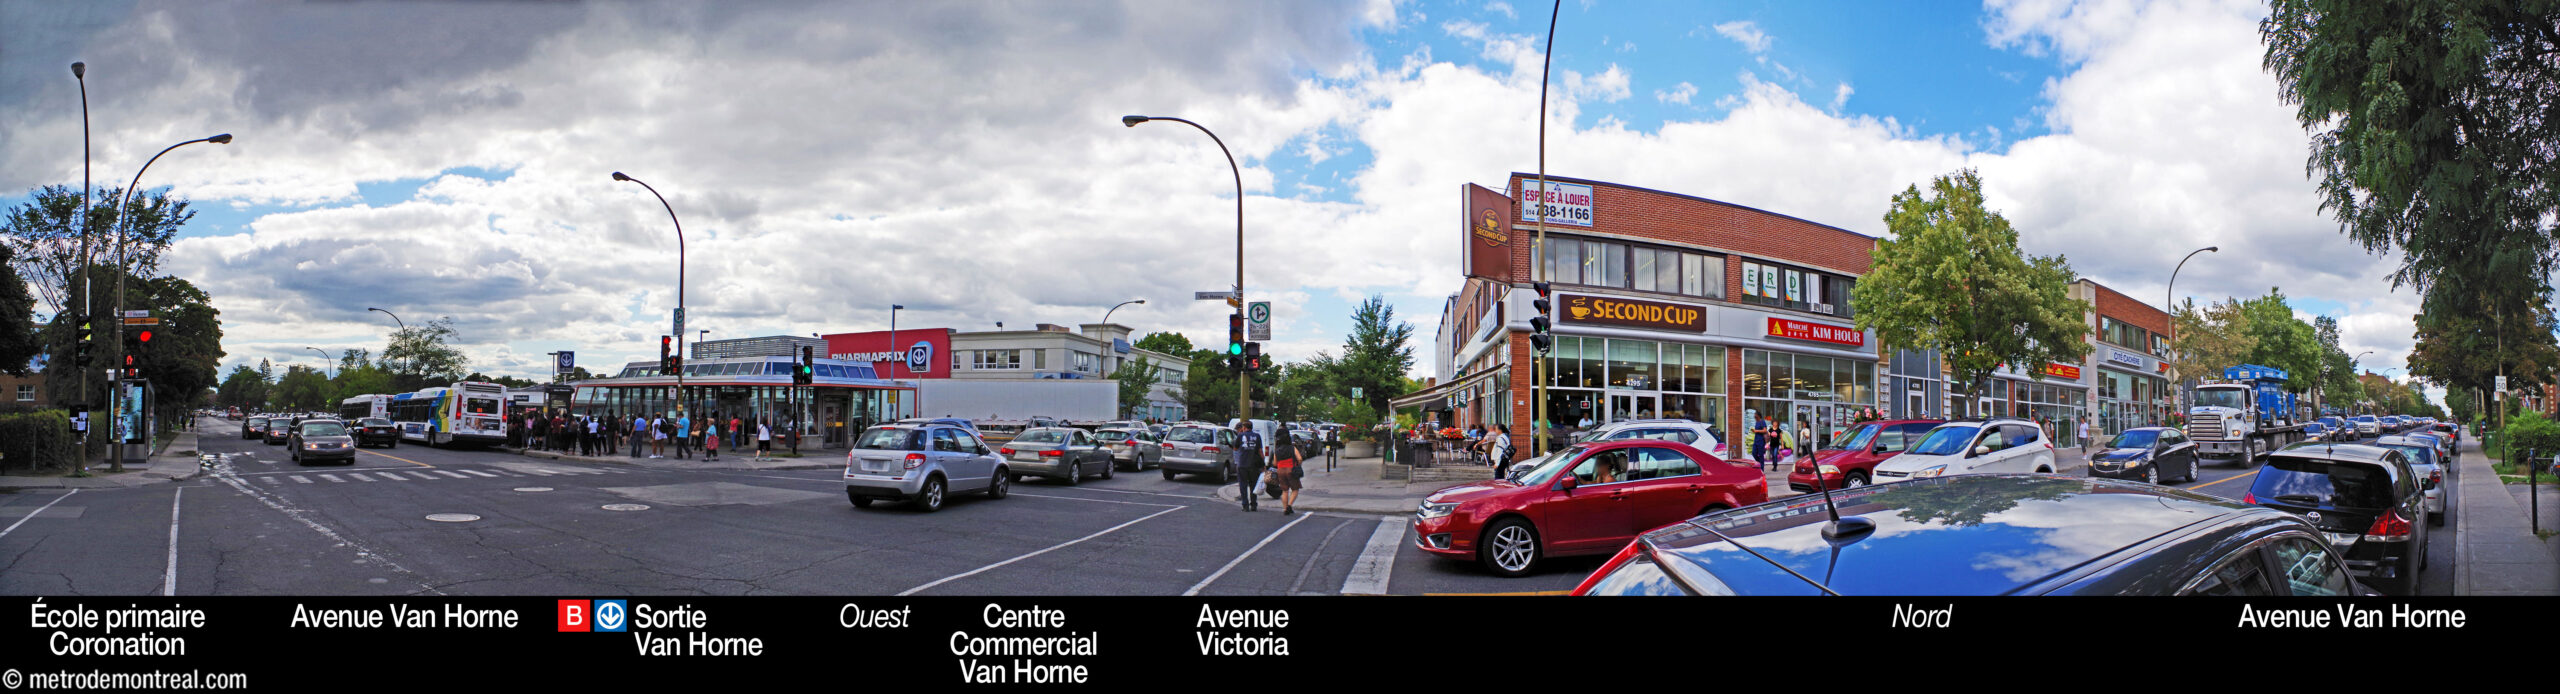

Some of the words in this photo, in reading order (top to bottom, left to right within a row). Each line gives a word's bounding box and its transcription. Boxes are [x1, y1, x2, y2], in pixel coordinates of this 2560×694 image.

[1525, 190, 1555, 203] ESPCE
[1565, 193, 1590, 206] LOUER
[1535, 204, 1589, 220] 738-1166
[1748, 269, 1754, 282] E
[1767, 272, 1774, 285] R
[1789, 275, 1796, 288] D
[1593, 299, 1663, 322] SECOND
[1664, 306, 1698, 325] CUP
[1812, 326, 1831, 340] KIM
[1834, 329, 1861, 343] HOUR
[832, 352, 906, 362] PHARMAPRIX
[1252, 358, 1259, 368] 5
